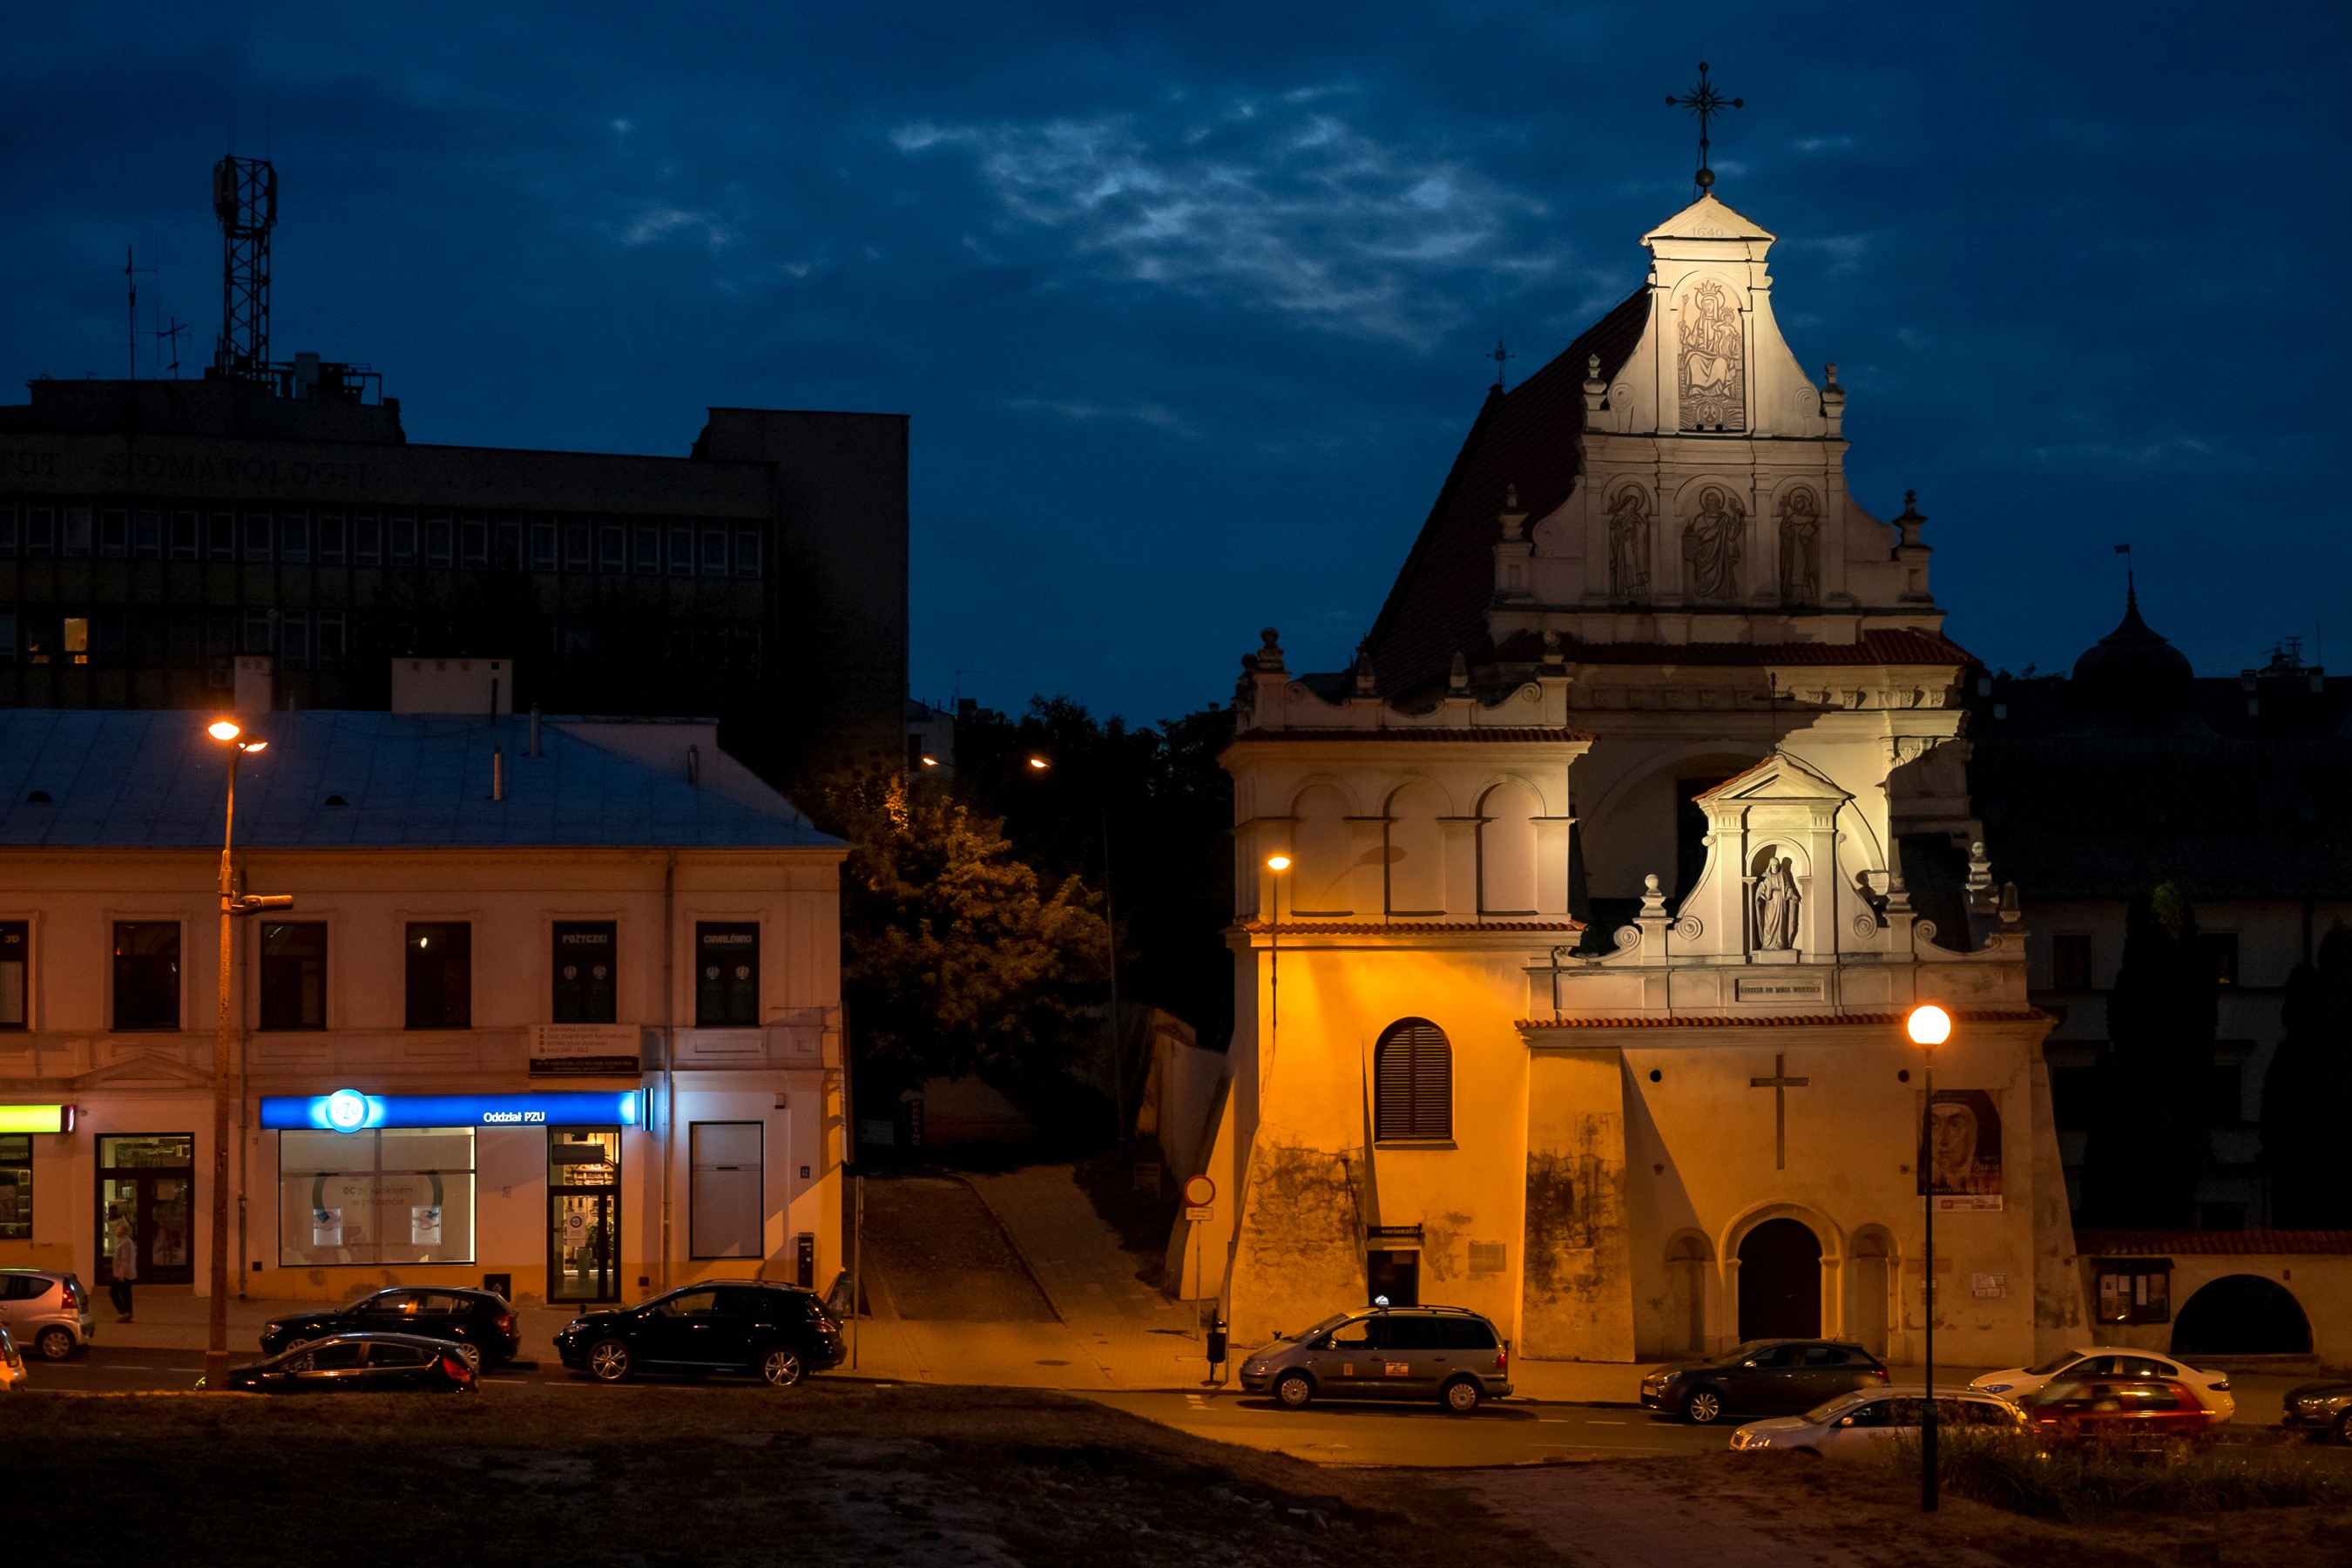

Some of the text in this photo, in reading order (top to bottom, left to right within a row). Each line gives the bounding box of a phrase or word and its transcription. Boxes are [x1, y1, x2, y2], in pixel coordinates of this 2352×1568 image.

[1692, 227, 1724, 237] 1640
[563, 932, 608, 943] POŻYCZKI
[704, 933, 753, 943] CHWILÓWKI
[483, 1112, 545, 1122] Oddział PZU
[343, 1186, 355, 1195] OC
[370, 1186, 414, 1196] spokojem
[362, 1199, 405, 1207] prezencie
